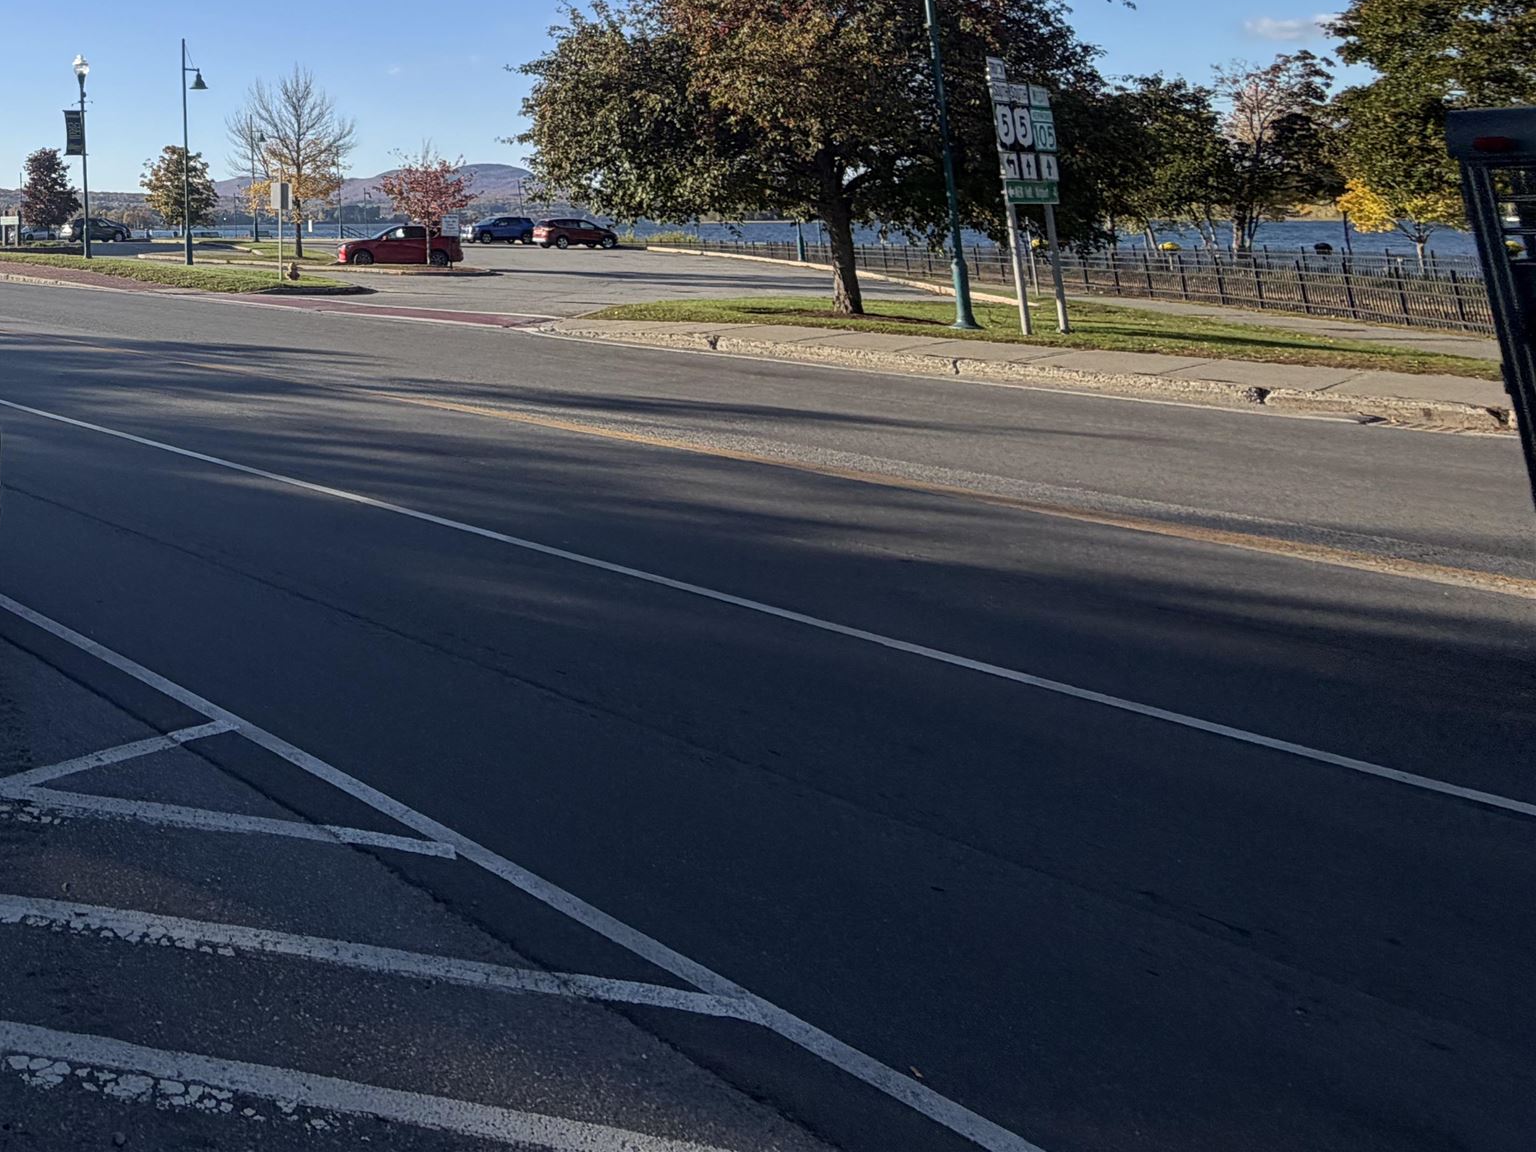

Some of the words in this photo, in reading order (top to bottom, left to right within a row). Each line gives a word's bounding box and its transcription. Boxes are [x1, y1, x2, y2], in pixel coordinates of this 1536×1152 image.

[1001, 113, 1010, 137] 5
[1019, 115, 1028, 139] 5
[1033, 124, 1056, 148] 105
